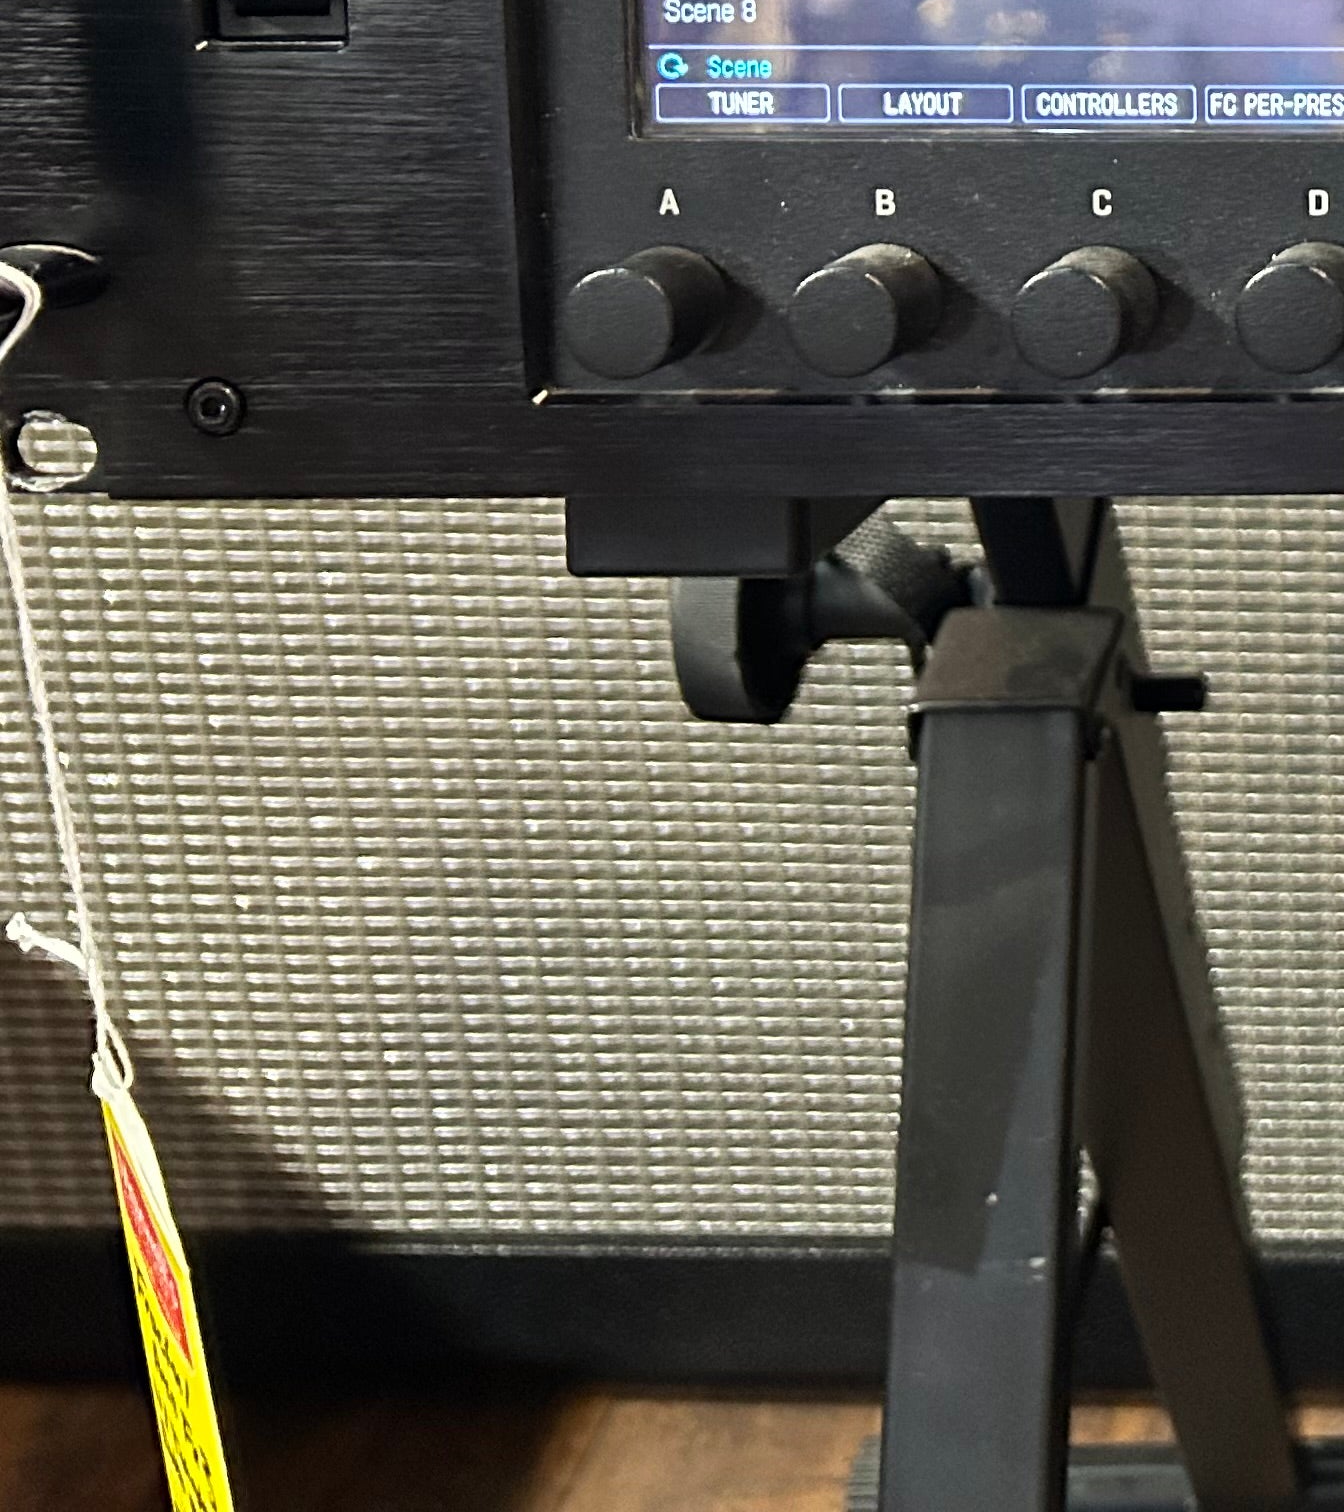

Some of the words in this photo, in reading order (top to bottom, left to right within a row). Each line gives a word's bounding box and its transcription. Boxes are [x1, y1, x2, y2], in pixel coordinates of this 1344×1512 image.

[706, 54, 773, 79] Scene
[708, 90, 775, 116] TUNER
[883, 91, 963, 117] LAYOUT
[1036, 91, 1178, 117] CONTROLLERS
[1209, 91, 1238, 117] FC
[659, 188, 680, 216] A
[875, 188, 896, 216] B
[1092, 188, 1113, 217] C
[1308, 188, 1330, 217] D
